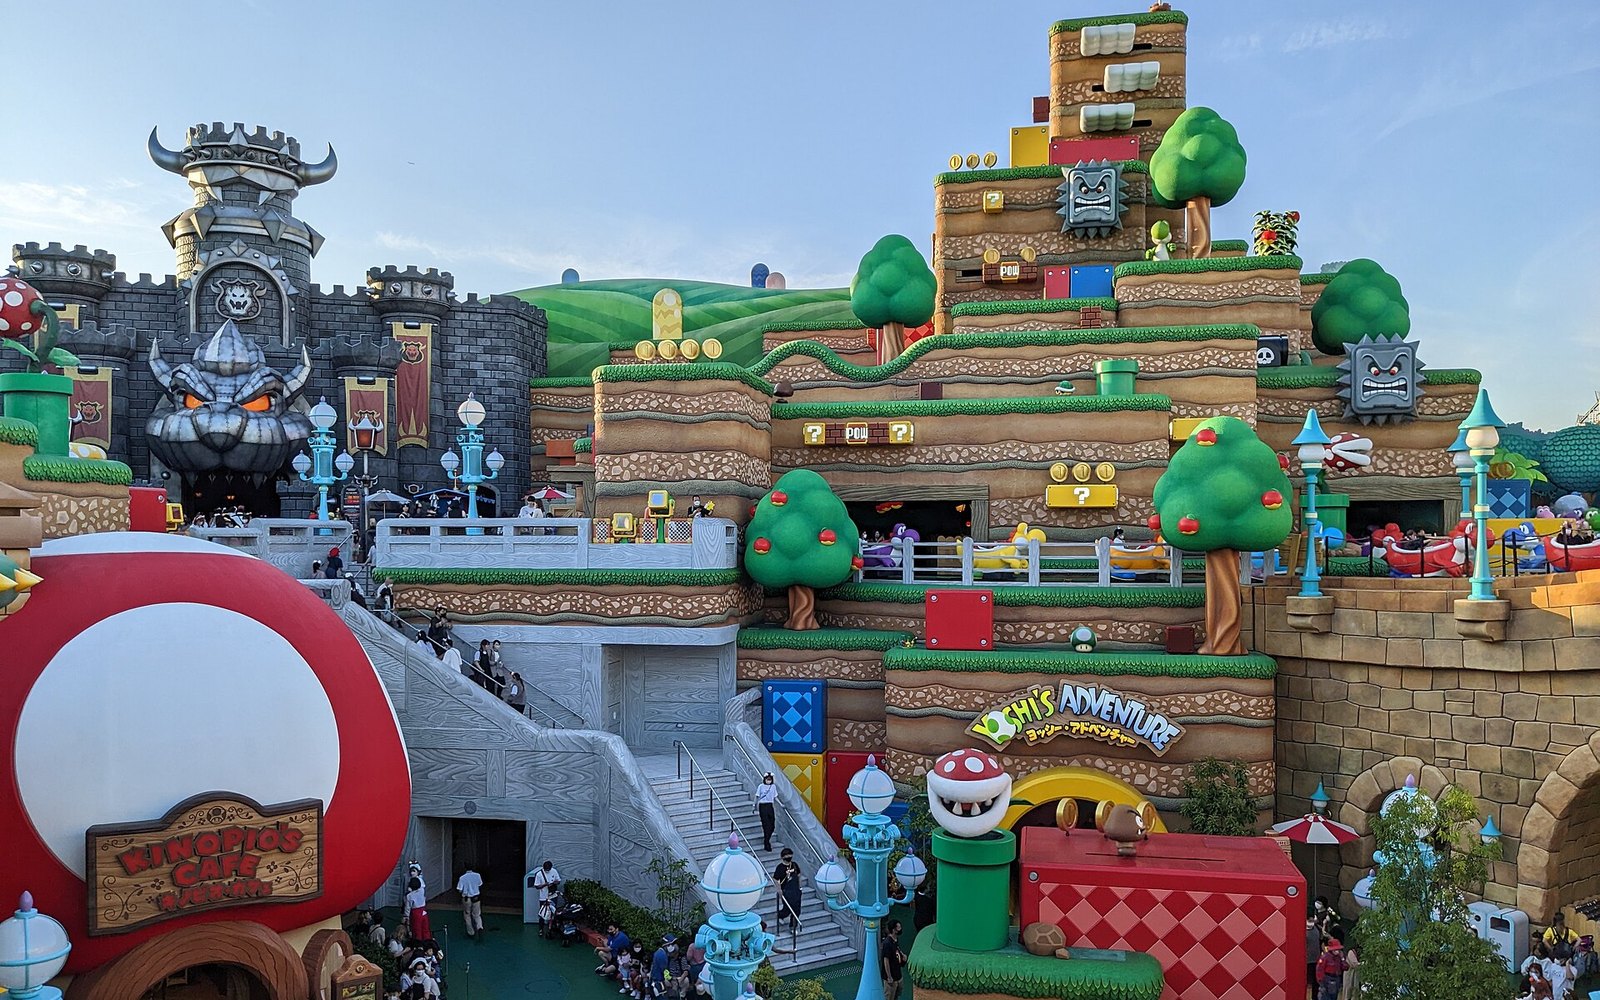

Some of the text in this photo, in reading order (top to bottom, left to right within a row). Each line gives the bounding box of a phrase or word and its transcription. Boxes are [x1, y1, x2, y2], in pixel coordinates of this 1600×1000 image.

[1000, 265, 1020, 277] POW
[845, 427, 869, 440] POW
[971, 683, 1181, 751] YOSHI'S ADVENTURE
[117, 822, 305, 875] KINOPIO'S
[172, 852, 262, 888] CAFE
